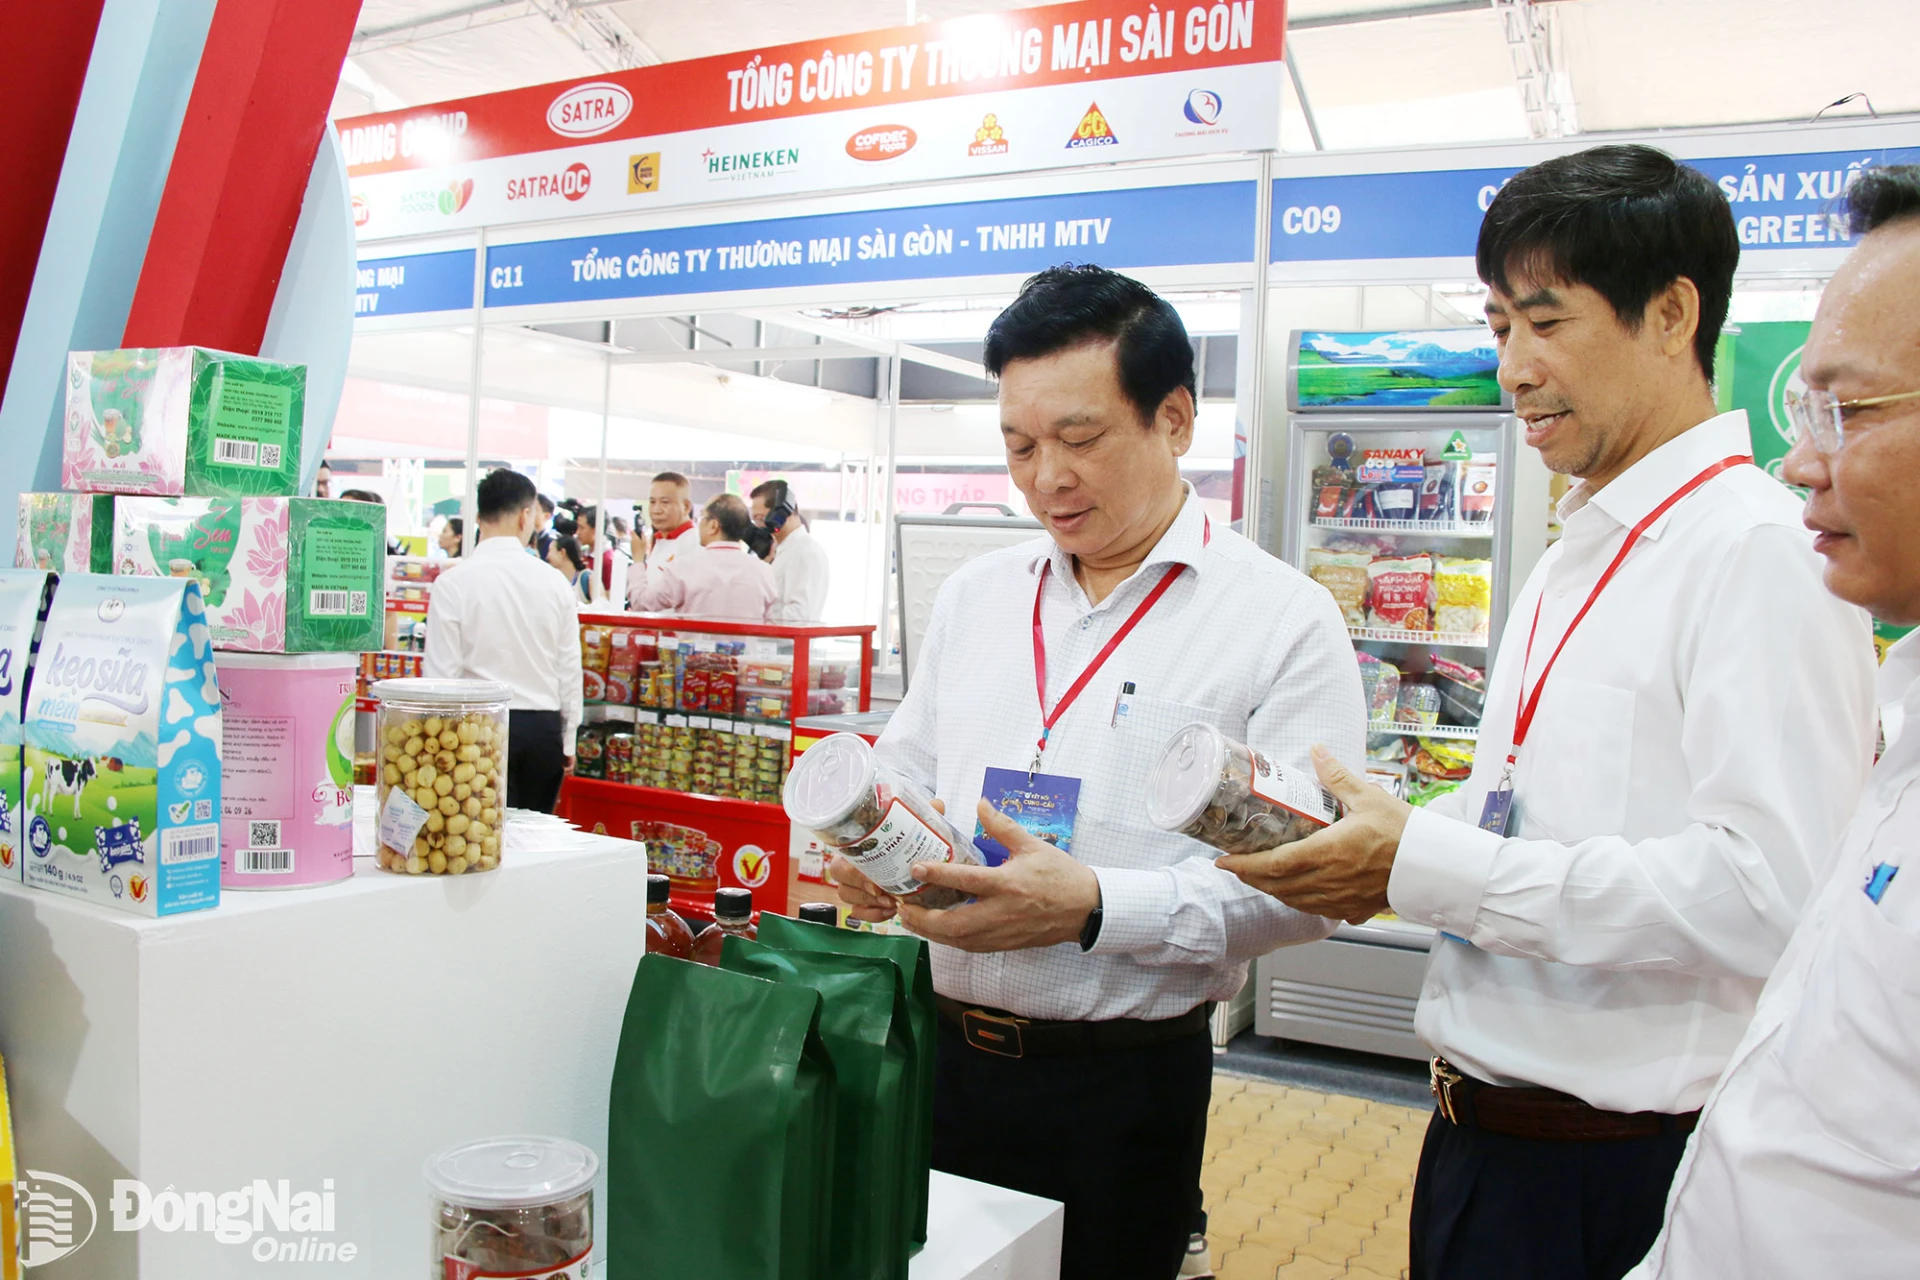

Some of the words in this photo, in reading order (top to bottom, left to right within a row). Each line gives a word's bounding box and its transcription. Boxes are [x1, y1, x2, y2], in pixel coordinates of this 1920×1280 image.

[727, 54, 794, 112] TỔNG
[799, 50, 874, 103] CÔNG
[879, 43, 919, 92] TY
[1050, 18, 1112, 74] MẠI
[1119, 3, 1175, 63] SÀI
[1184, 0, 1255, 55] GÒN
[561, 95, 616, 126] SATRA
[855, 130, 908, 147] COFIDEC
[879, 142, 907, 154] FOODS
[970, 144, 1007, 155] VISSAN
[1070, 136, 1114, 148] CAGICO
[708, 147, 799, 174] HEINEKEN
[506, 177, 559, 201] SATRA
[563, 168, 589, 196] DC
[730, 170, 775, 182] VIETNAM
[1717, 163, 1785, 203] SẢN
[1282, 204, 1342, 236] C09
[571, 247, 622, 282] TỔNG
[626, 247, 680, 278] CÔNG
[685, 247, 711, 273] TY
[716, 239, 802, 271] THƯƠNG
[808, 236, 851, 267] MẠI
[857, 228, 896, 260] SÀI
[903, 224, 953, 257] GÒN
[960, 239, 970, 247] -
[976, 222, 1046, 252] TNHH
[1054, 217, 1112, 248] MTV
[377, 265, 405, 289] MẠI
[490, 265, 523, 289] C11
[1363, 448, 1426, 459] SANAKY
